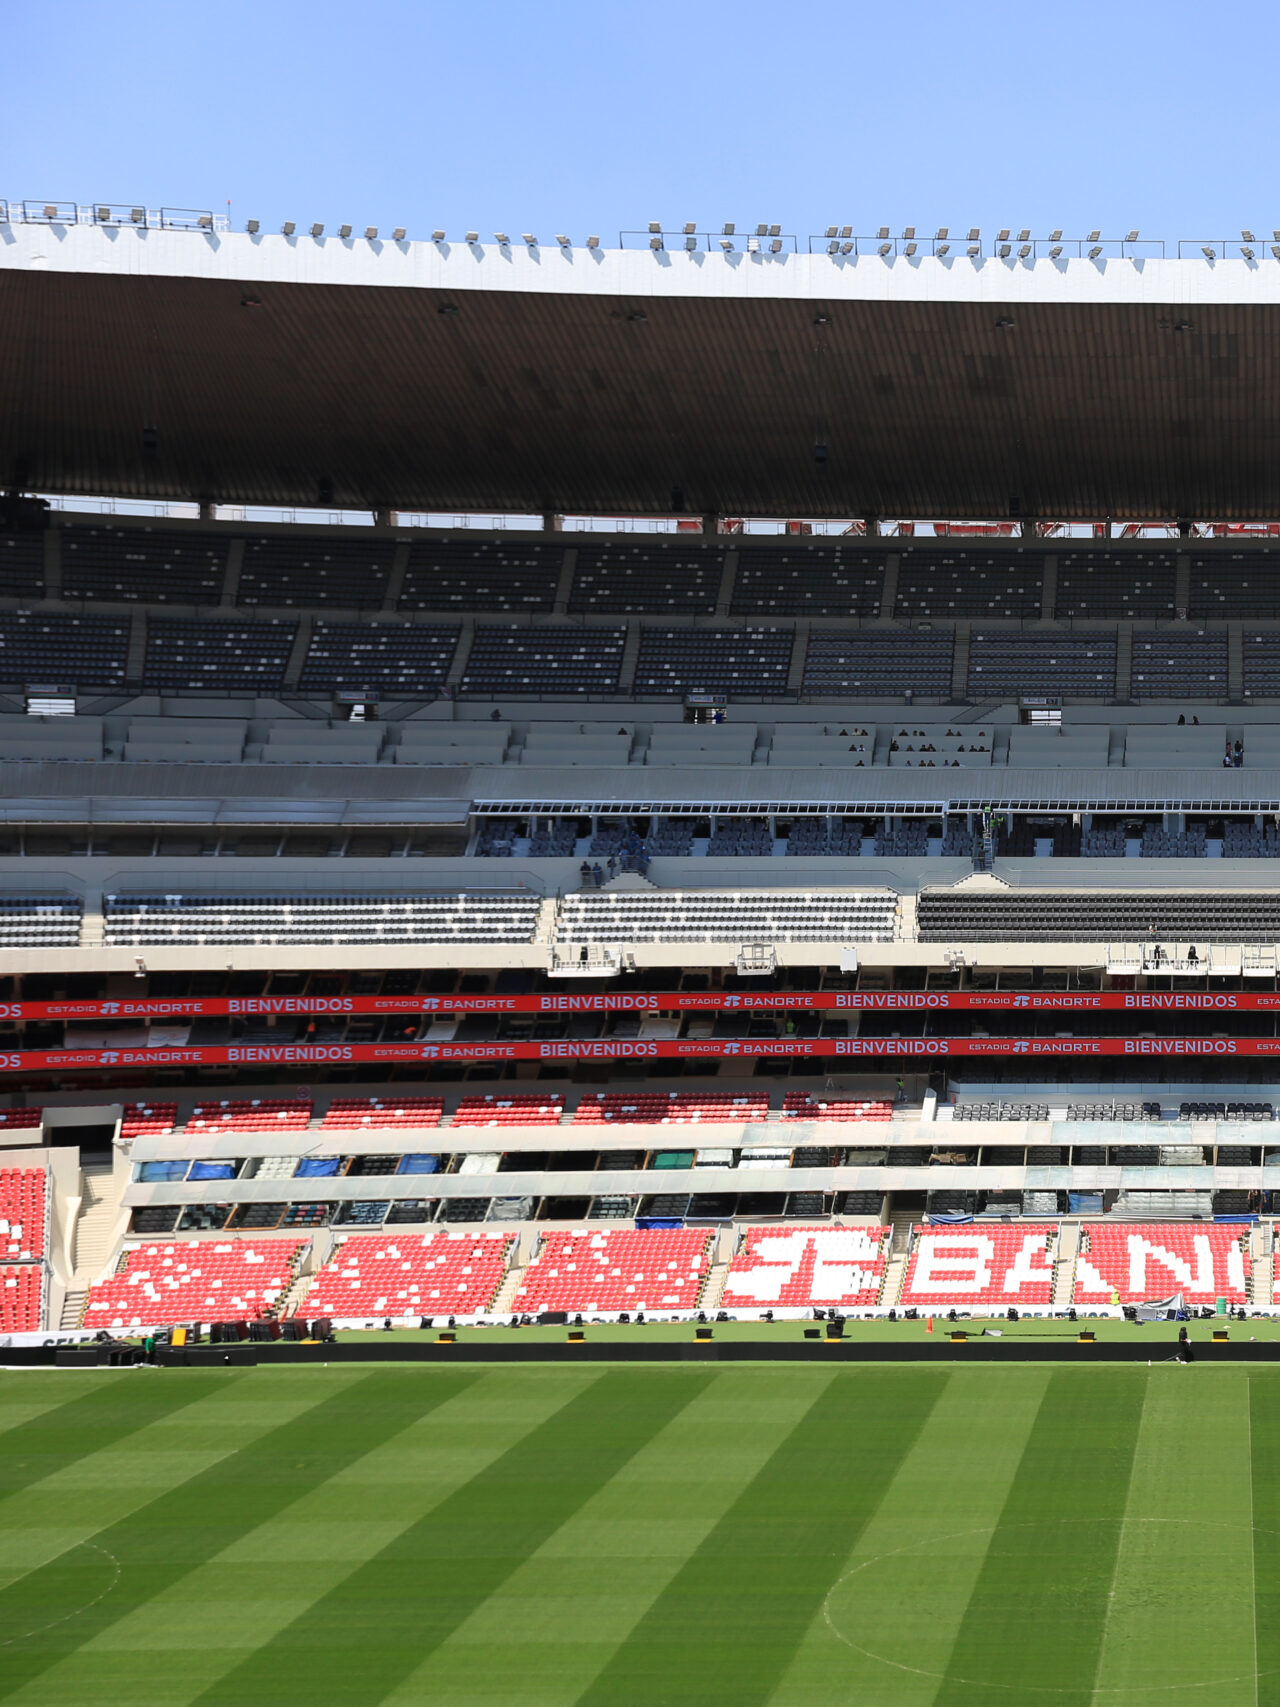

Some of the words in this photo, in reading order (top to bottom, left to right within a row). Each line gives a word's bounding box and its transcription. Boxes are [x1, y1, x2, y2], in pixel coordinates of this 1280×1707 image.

[229, 998, 353, 1012] BIENVENIDOS
[443, 1000, 515, 1009] BANORTE
[541, 996, 658, 1009] BIENVENIDOS
[744, 998, 814, 1006] BANORTE
[836, 995, 949, 1007] BIENVENIDOS
[1033, 998, 1101, 1006] BANORTE
[1125, 995, 1237, 1007] BIENVENIDOS
[123, 1003, 203, 1013] BANORTE
[442, 1048, 514, 1057] BANORTE
[540, 1043, 658, 1056] BIENVENIDOS
[744, 1045, 814, 1053] BANORTE
[836, 1041, 949, 1053] BIENVENIDOS
[1033, 1044, 1101, 1052] BANORTE
[1125, 1041, 1237, 1053] BIENVENIDOS
[122, 1052, 202, 1062] BANORTE
[228, 1047, 352, 1061] BIENVENIDOS
